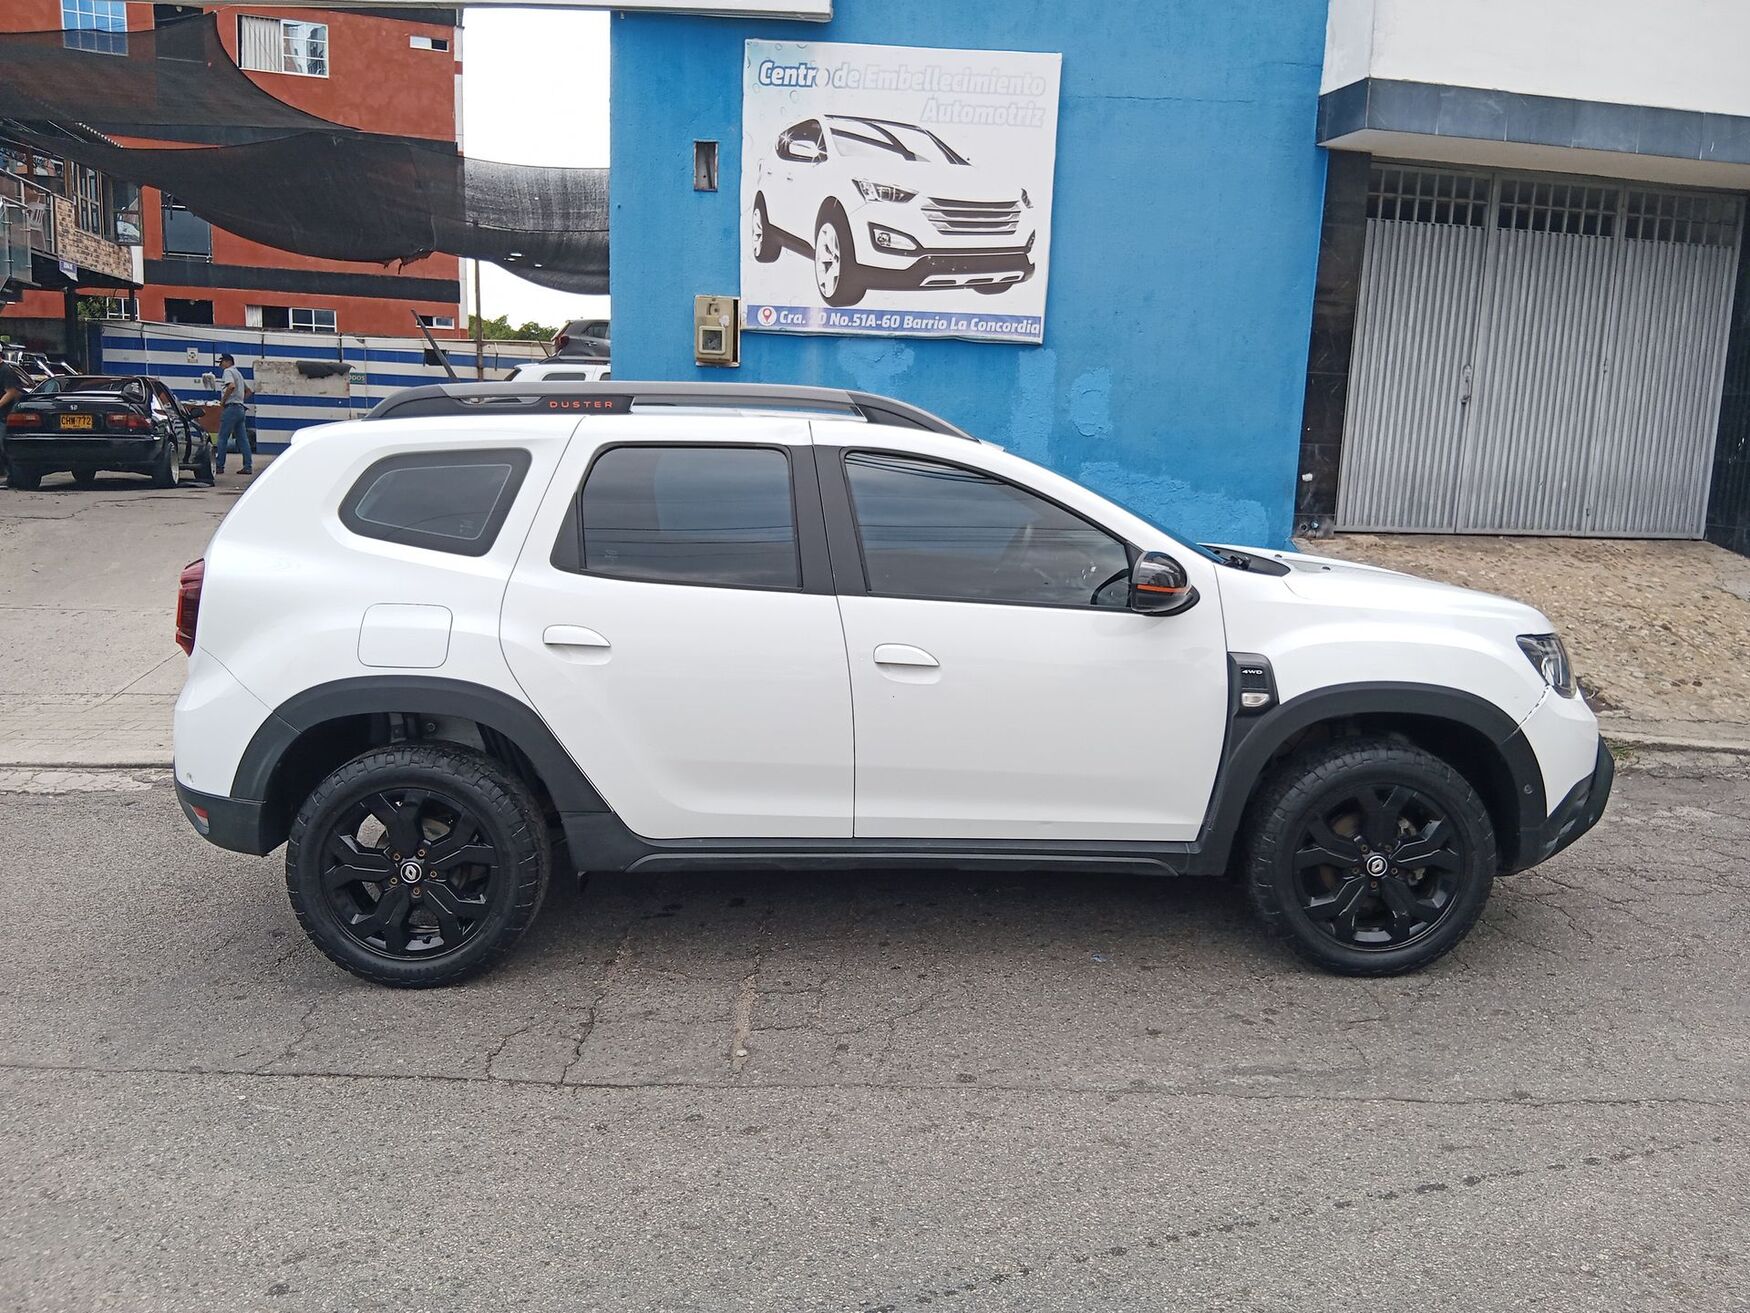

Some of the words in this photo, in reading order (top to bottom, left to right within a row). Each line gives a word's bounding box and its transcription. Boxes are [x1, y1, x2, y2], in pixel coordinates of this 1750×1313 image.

[832, 62, 861, 89] de
[863, 64, 1047, 97] Embellecimiento
[920, 96, 1047, 128] Automotriz
[780, 311, 806, 324] Cra.
[903, 315, 947, 330] Barrio
[950, 317, 967, 330] La
[970, 318, 1040, 334] Concordia
[549, 401, 613, 409] DUSTER
